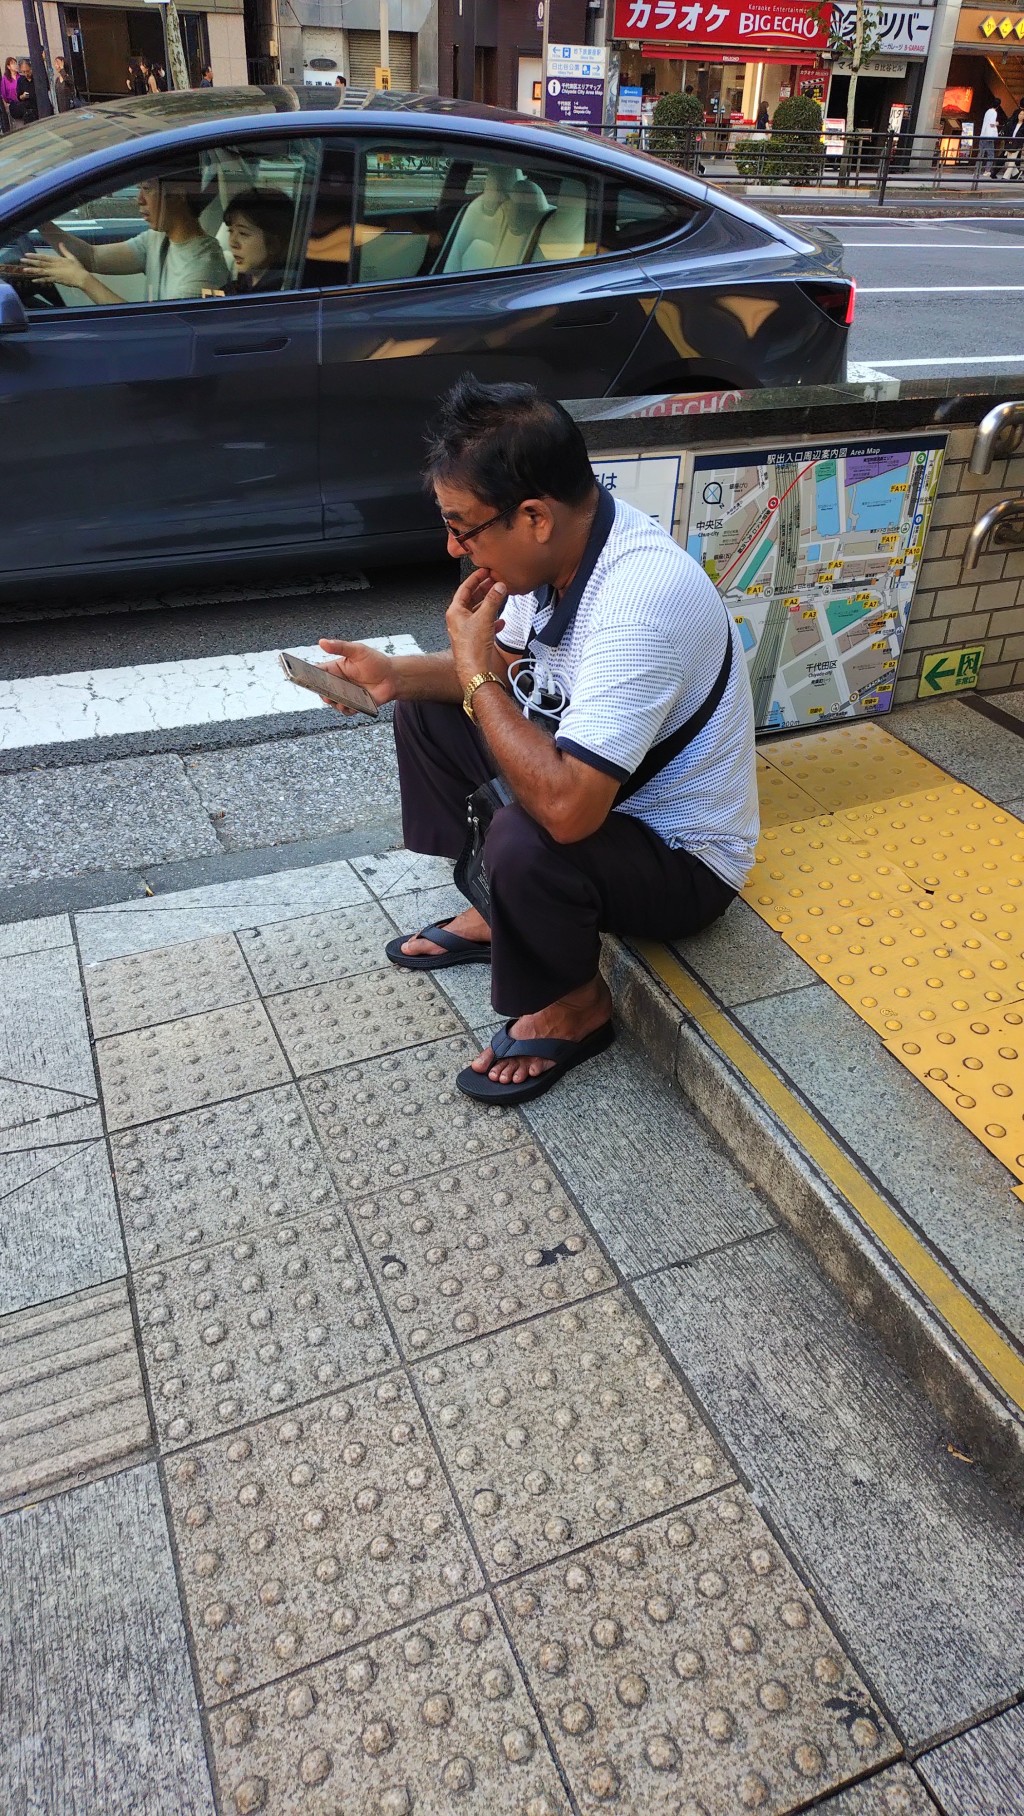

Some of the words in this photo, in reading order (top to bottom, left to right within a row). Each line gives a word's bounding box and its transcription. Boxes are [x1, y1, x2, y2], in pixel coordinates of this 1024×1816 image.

[748, 3, 771, 12] Karaoke
[626, 1, 730, 32] カラオケ
[738, 12, 771, 34] BIG
[773, 16, 819, 38] ECHO
[842, 8, 930, 42] ダツバー
[903, 44, 925, 52] B-GARAGE
[838, 61, 871, 71] マイミ
[874, 63, 904, 73] 日比谷ビル
[766, 447, 847, 465] 駅出入口周辺案内図
[696, 518, 724, 531] 中央区
[806, 660, 838, 672] 千代田区
[954, 675, 976, 686] 非常口
